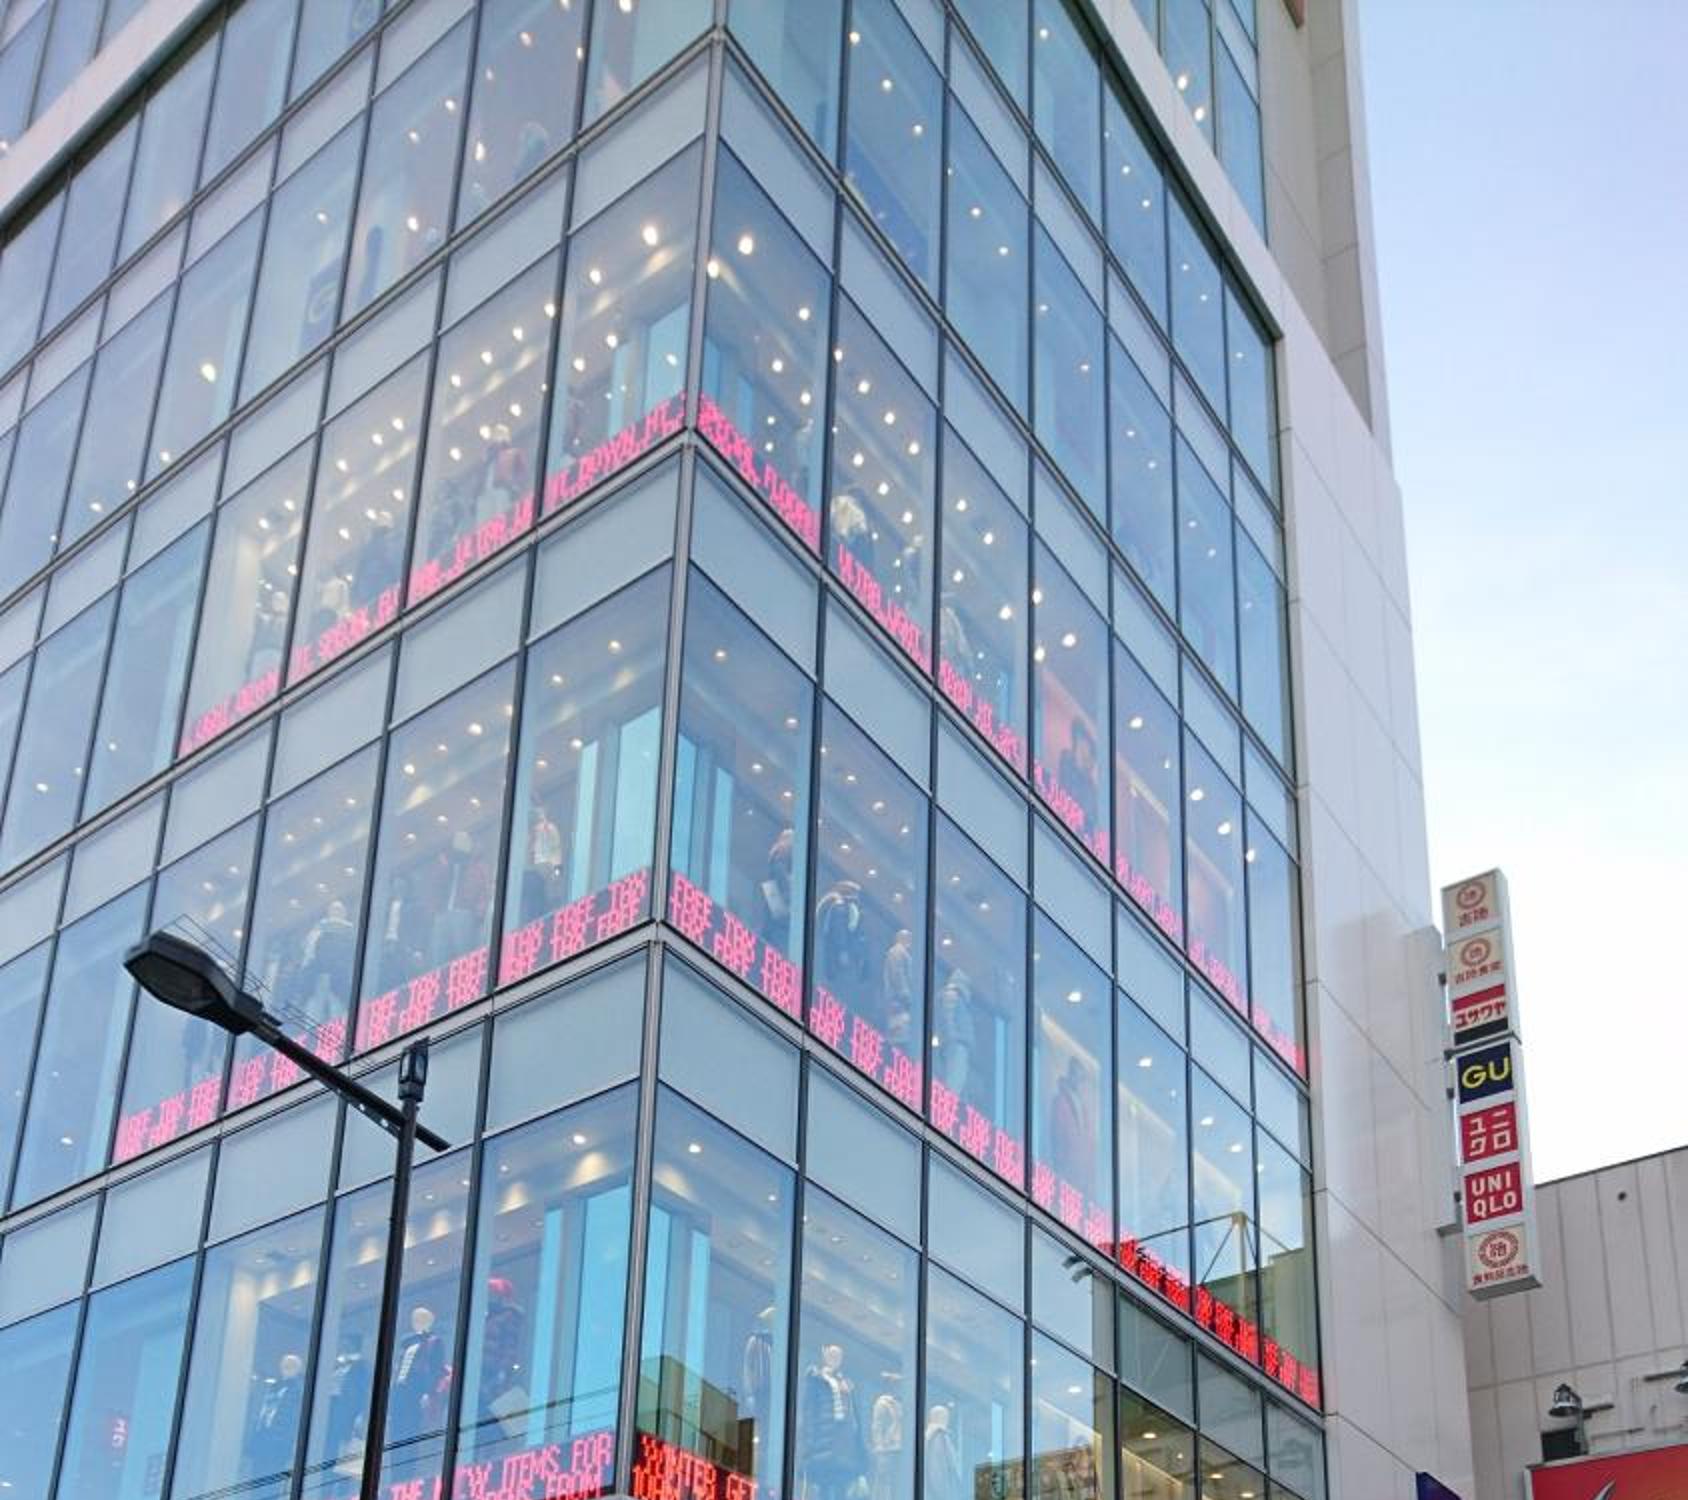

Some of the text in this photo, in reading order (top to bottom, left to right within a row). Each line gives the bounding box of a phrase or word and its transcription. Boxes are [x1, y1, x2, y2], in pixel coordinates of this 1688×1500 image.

[1462, 1057, 1509, 1088] GU
[1469, 1110, 1510, 1136] ユニ
[1469, 1130, 1511, 1156] クロ
[1471, 1171, 1512, 1196] UNI
[1473, 1192, 1517, 1218] QLO
